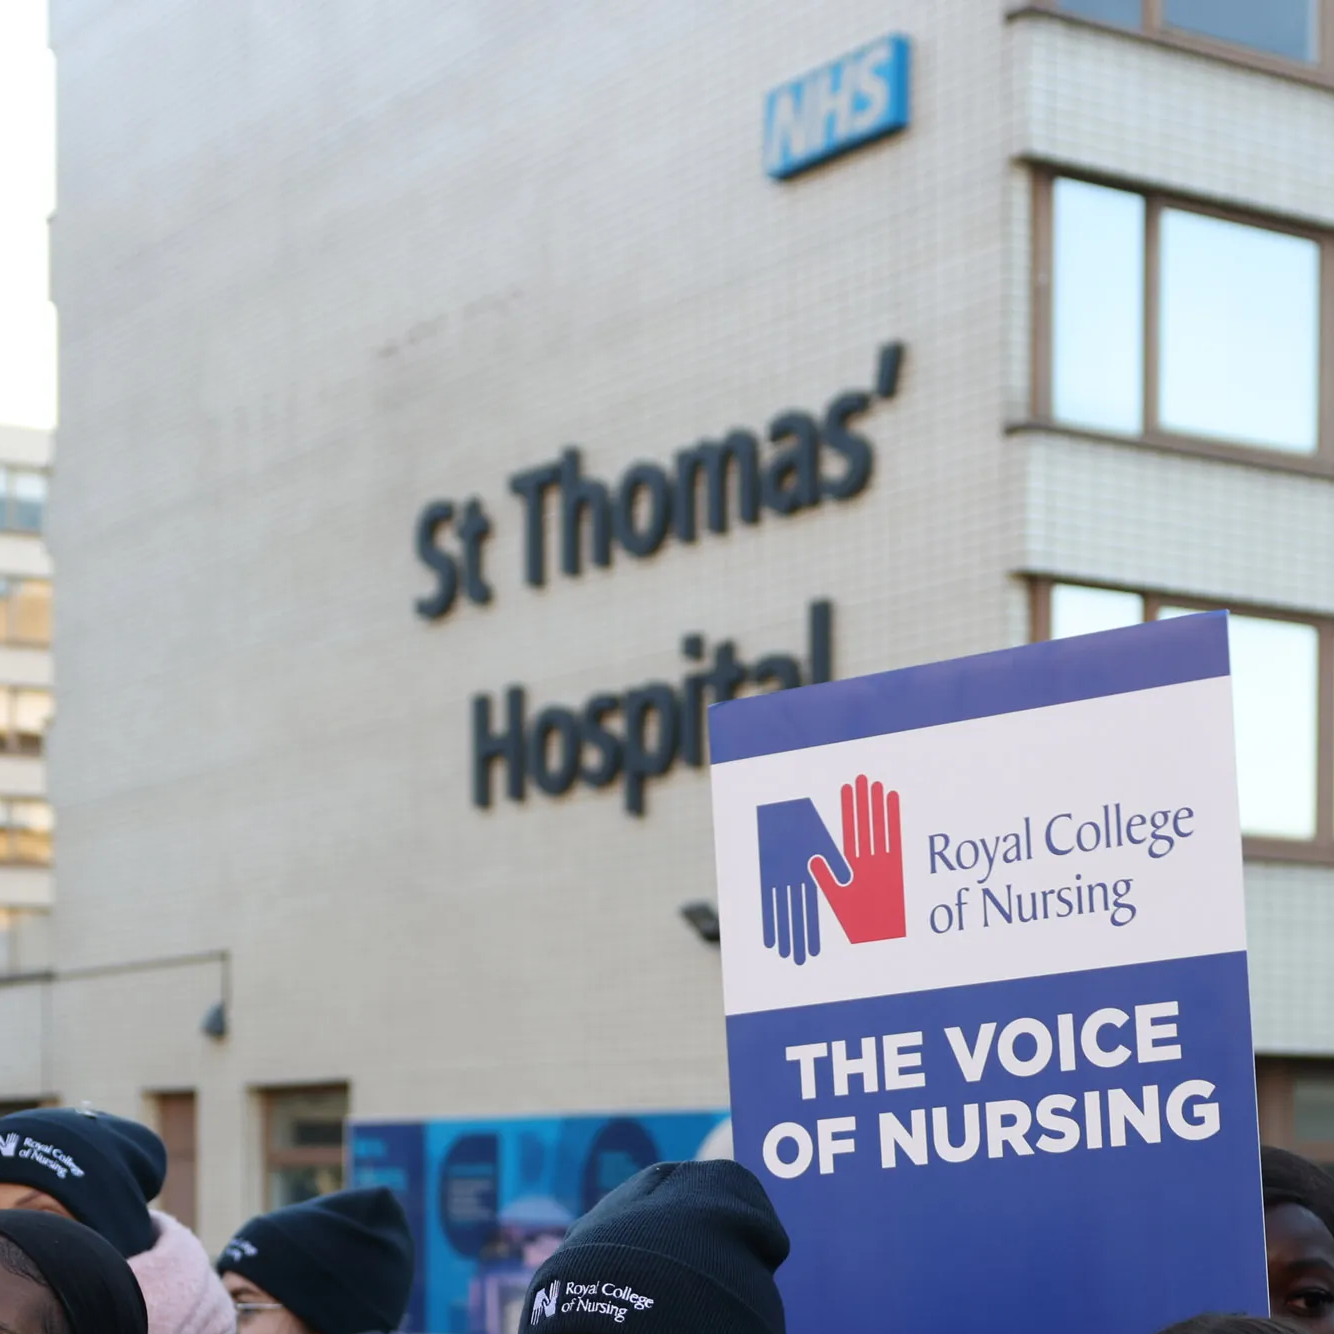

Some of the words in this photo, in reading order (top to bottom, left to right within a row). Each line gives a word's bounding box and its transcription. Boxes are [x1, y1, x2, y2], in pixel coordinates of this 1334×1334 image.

[766, 46, 892, 170] NHS
[414, 495, 493, 623] St
[927, 817, 1034, 884] Royal
[1044, 803, 1195, 859] College
[928, 887, 969, 934] of
[981, 873, 1138, 927] Nursing
[785, 1031, 926, 1100] THE
[943, 1000, 1182, 1082] VOICE
[18, 1148, 32, 1159] of
[23, 1137, 54, 1155] Royal
[762, 1116, 857, 1179] OF
[878, 1079, 1221, 1168] NURSING
[561, 1298, 576, 1313] of
[576, 1297, 628, 1323] Nursing
[566, 1281, 600, 1297] Royal
[601, 1283, 655, 1311] College
